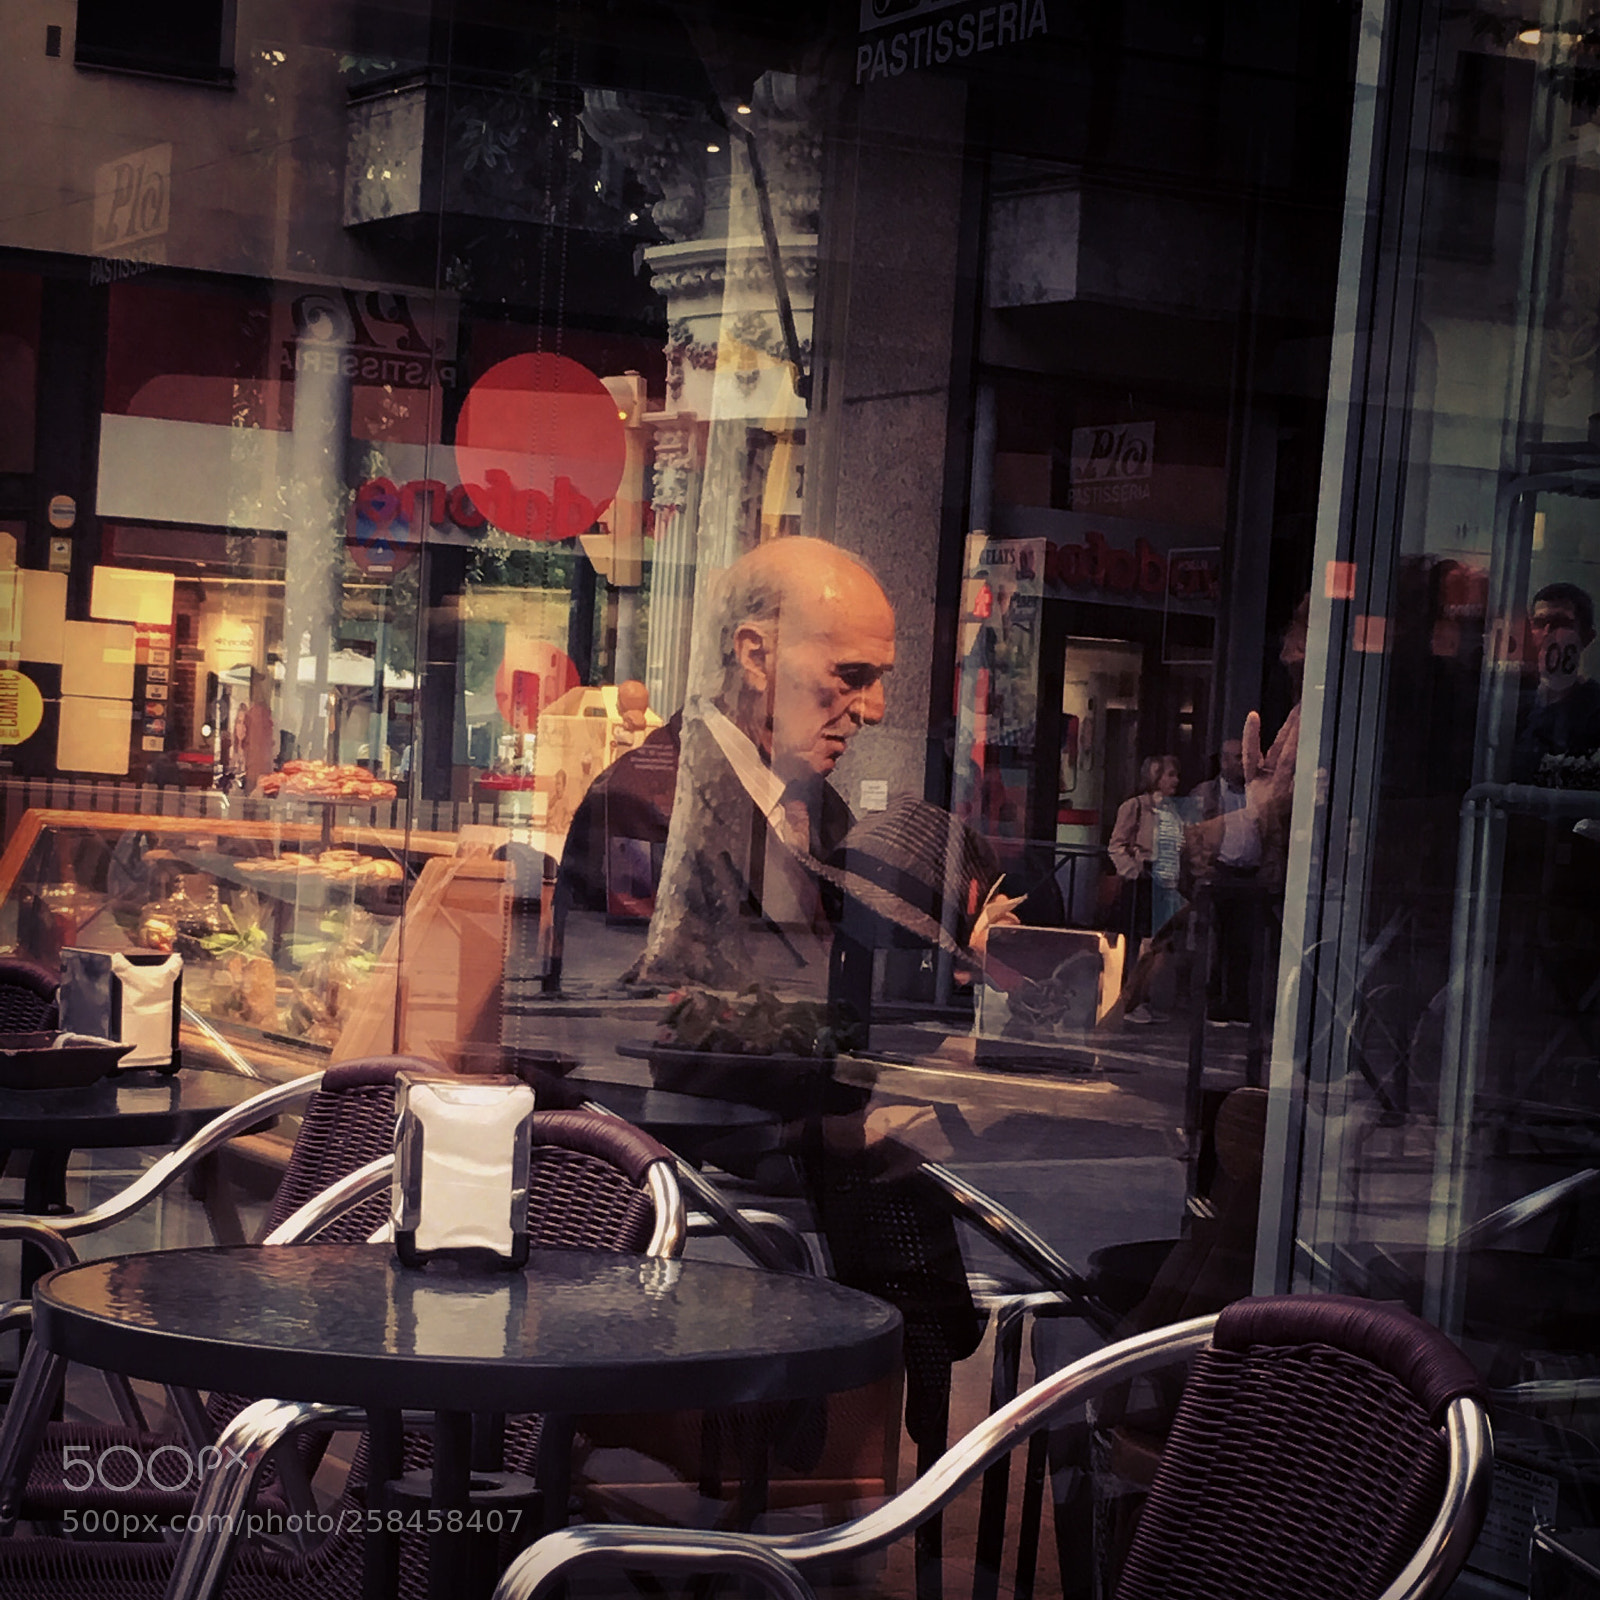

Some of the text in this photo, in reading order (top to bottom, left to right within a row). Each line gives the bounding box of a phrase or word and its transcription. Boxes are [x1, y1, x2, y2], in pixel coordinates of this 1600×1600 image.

[855, 0, 1049, 86] PASTISSERIA
[1075, 428, 1147, 479] Pla
[1067, 483, 1150, 506] PASTISSERIA
